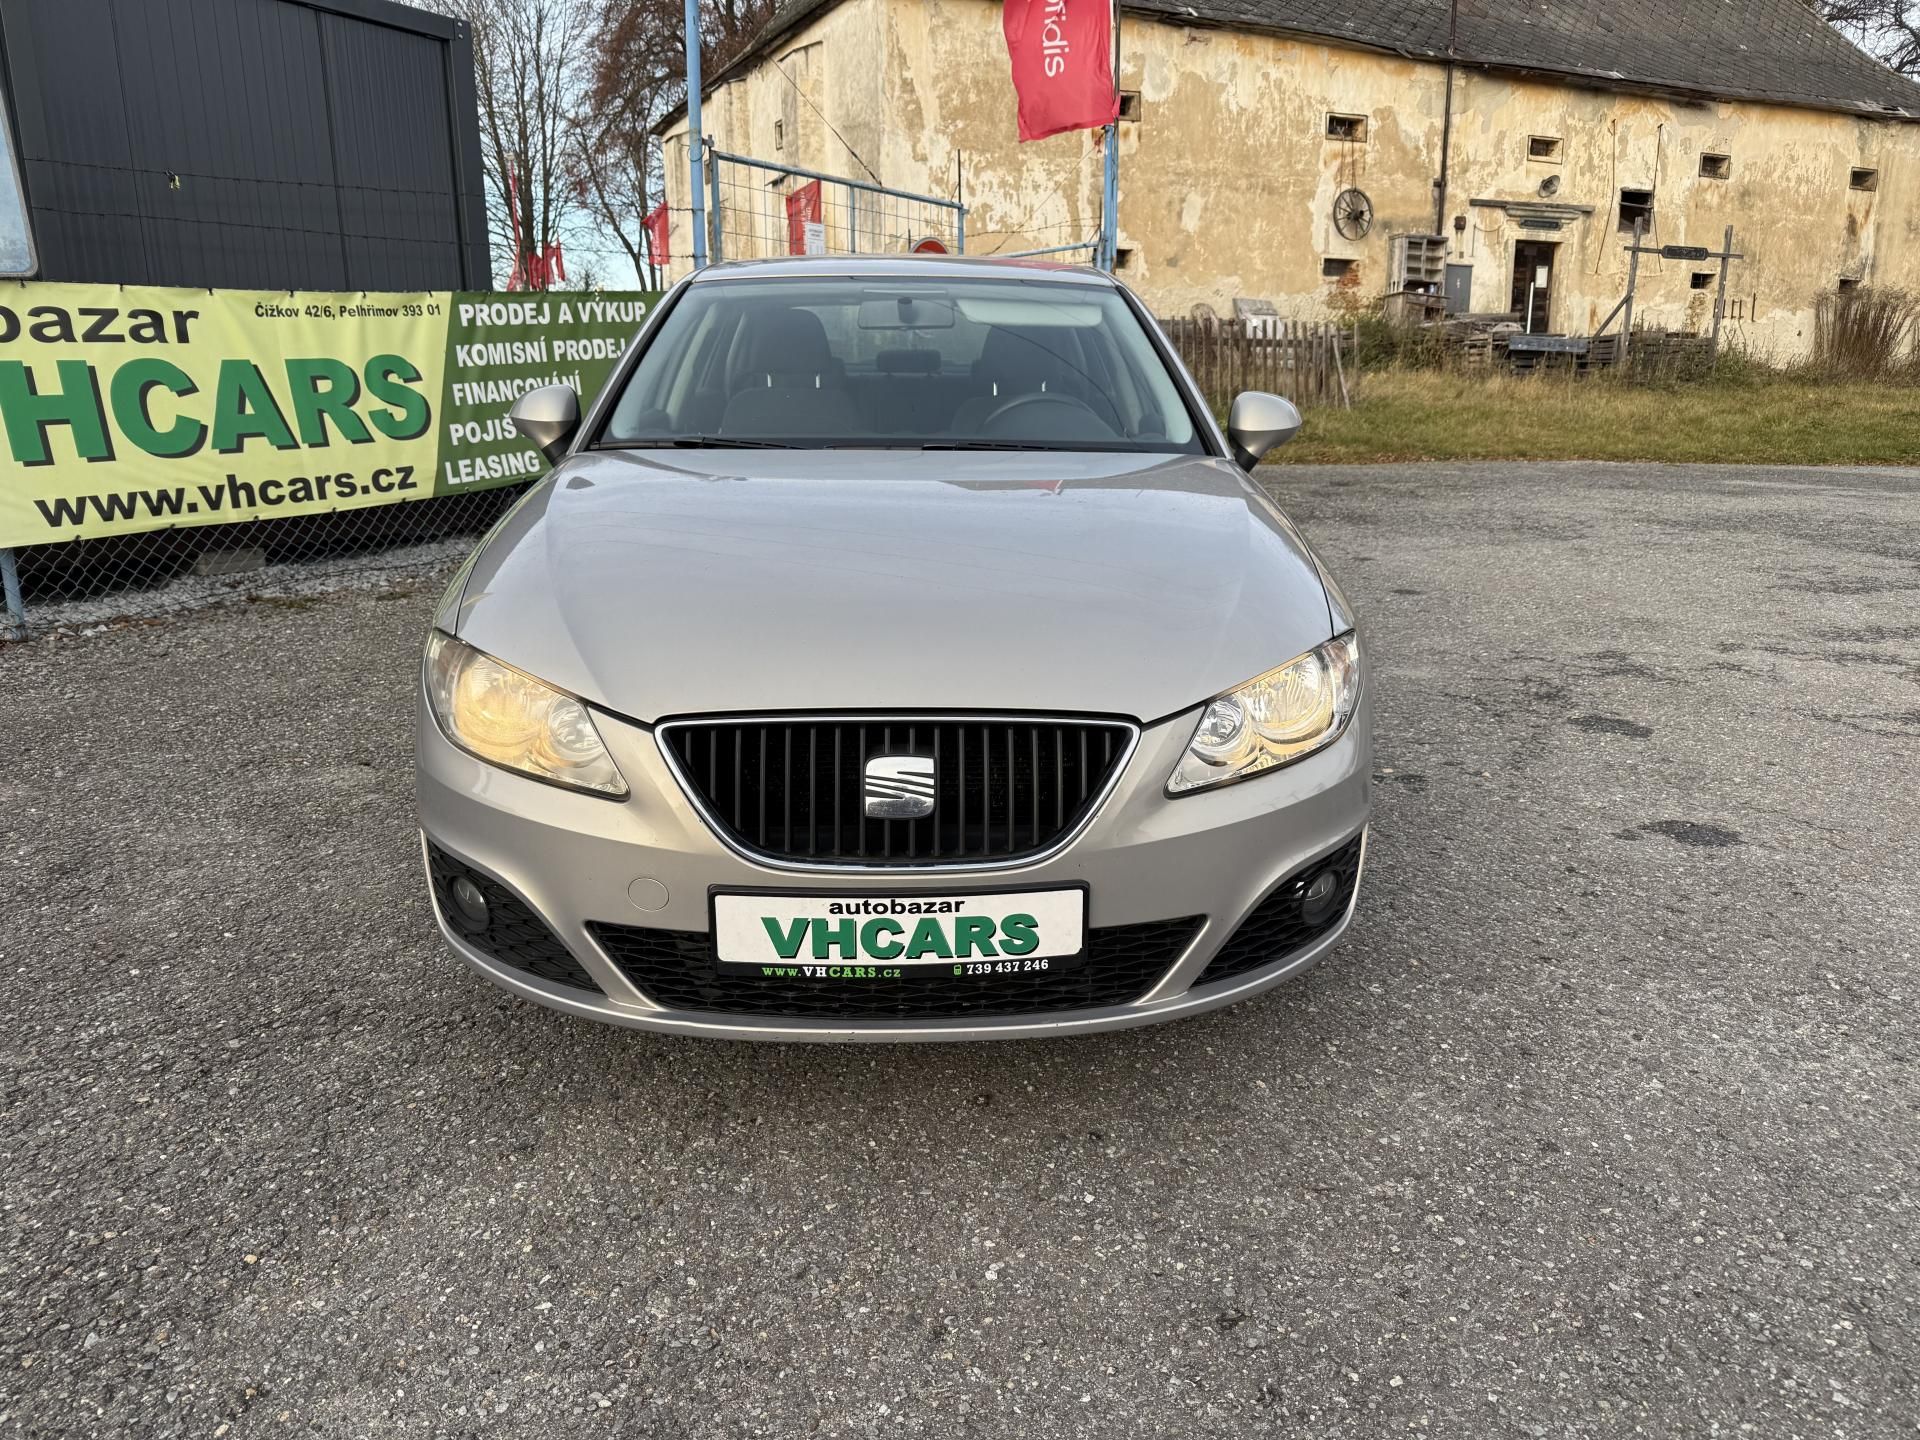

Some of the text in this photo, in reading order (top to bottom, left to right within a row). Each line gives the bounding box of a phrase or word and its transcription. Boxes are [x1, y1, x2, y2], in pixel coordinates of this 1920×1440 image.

[1042, 0, 1070, 78] fidis
[255, 302, 441, 320] Čížkov 42/6, Pelhřimov 393 01
[459, 297, 647, 327] PRODEJ A VÝKUP
[455, 336, 626, 368] KOMISNÍ PRODEJ
[0, 354, 431, 468] HCARS
[449, 412, 526, 446] POJIŠ
[445, 450, 541, 485] LEASING
[33, 465, 418, 528] www.vhcars.cz
[829, 899, 965, 915] autobazar
[761, 913, 1040, 960] VHCARS
[762, 966, 901, 978] www.VHCARS.cz
[966, 959, 1049, 975] 739 437 246
